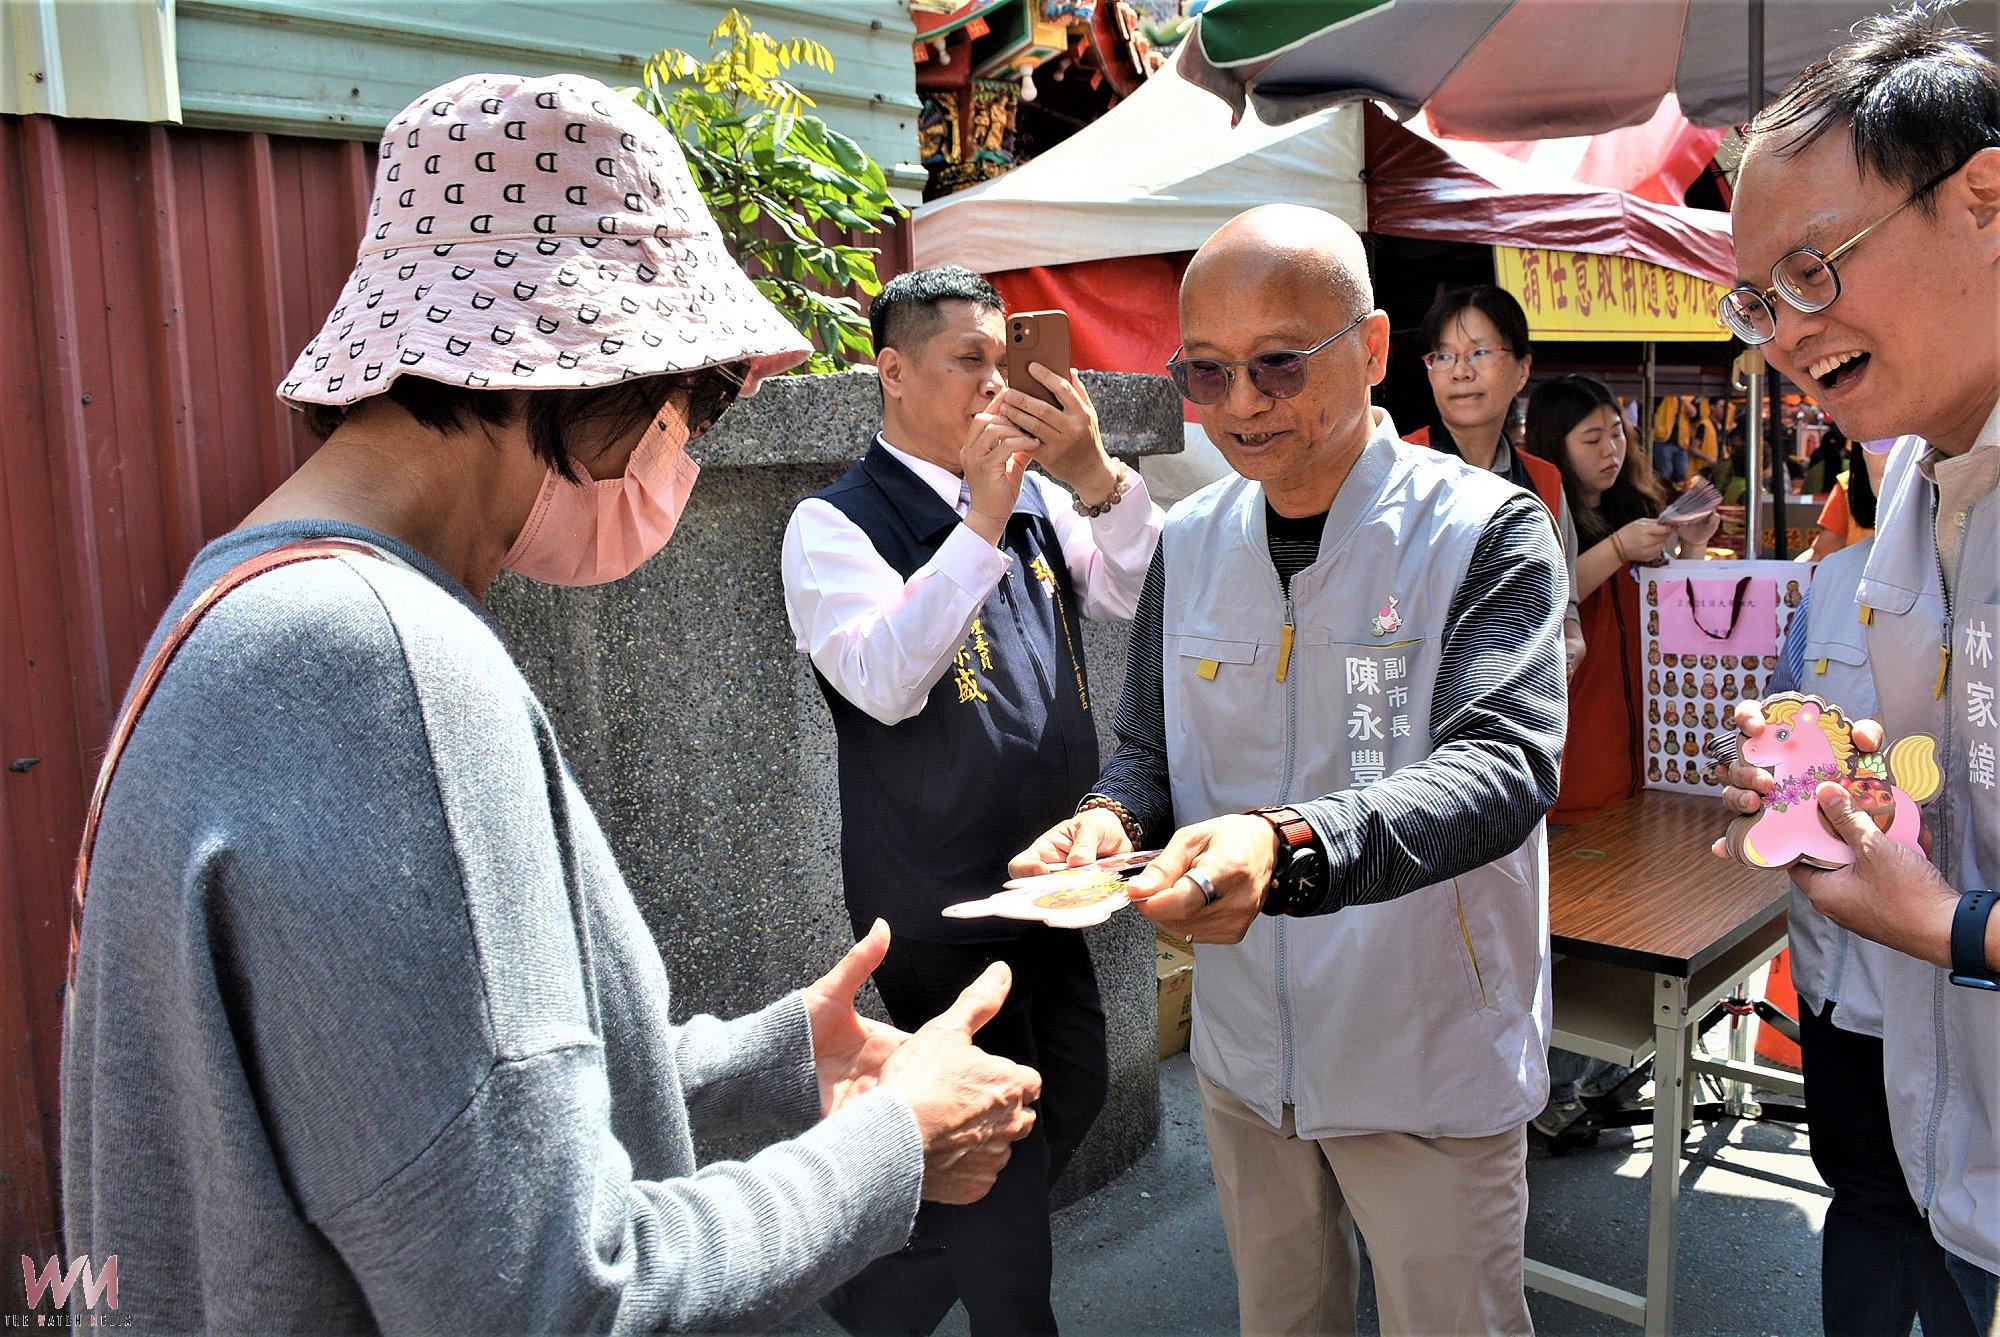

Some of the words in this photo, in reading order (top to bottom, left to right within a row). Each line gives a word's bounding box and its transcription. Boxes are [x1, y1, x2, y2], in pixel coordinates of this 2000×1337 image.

[1345, 656, 1386, 788] 陳永豐
[1383, 656, 1411, 739] 副市長
[1964, 618, 1998, 790] 林家緯
